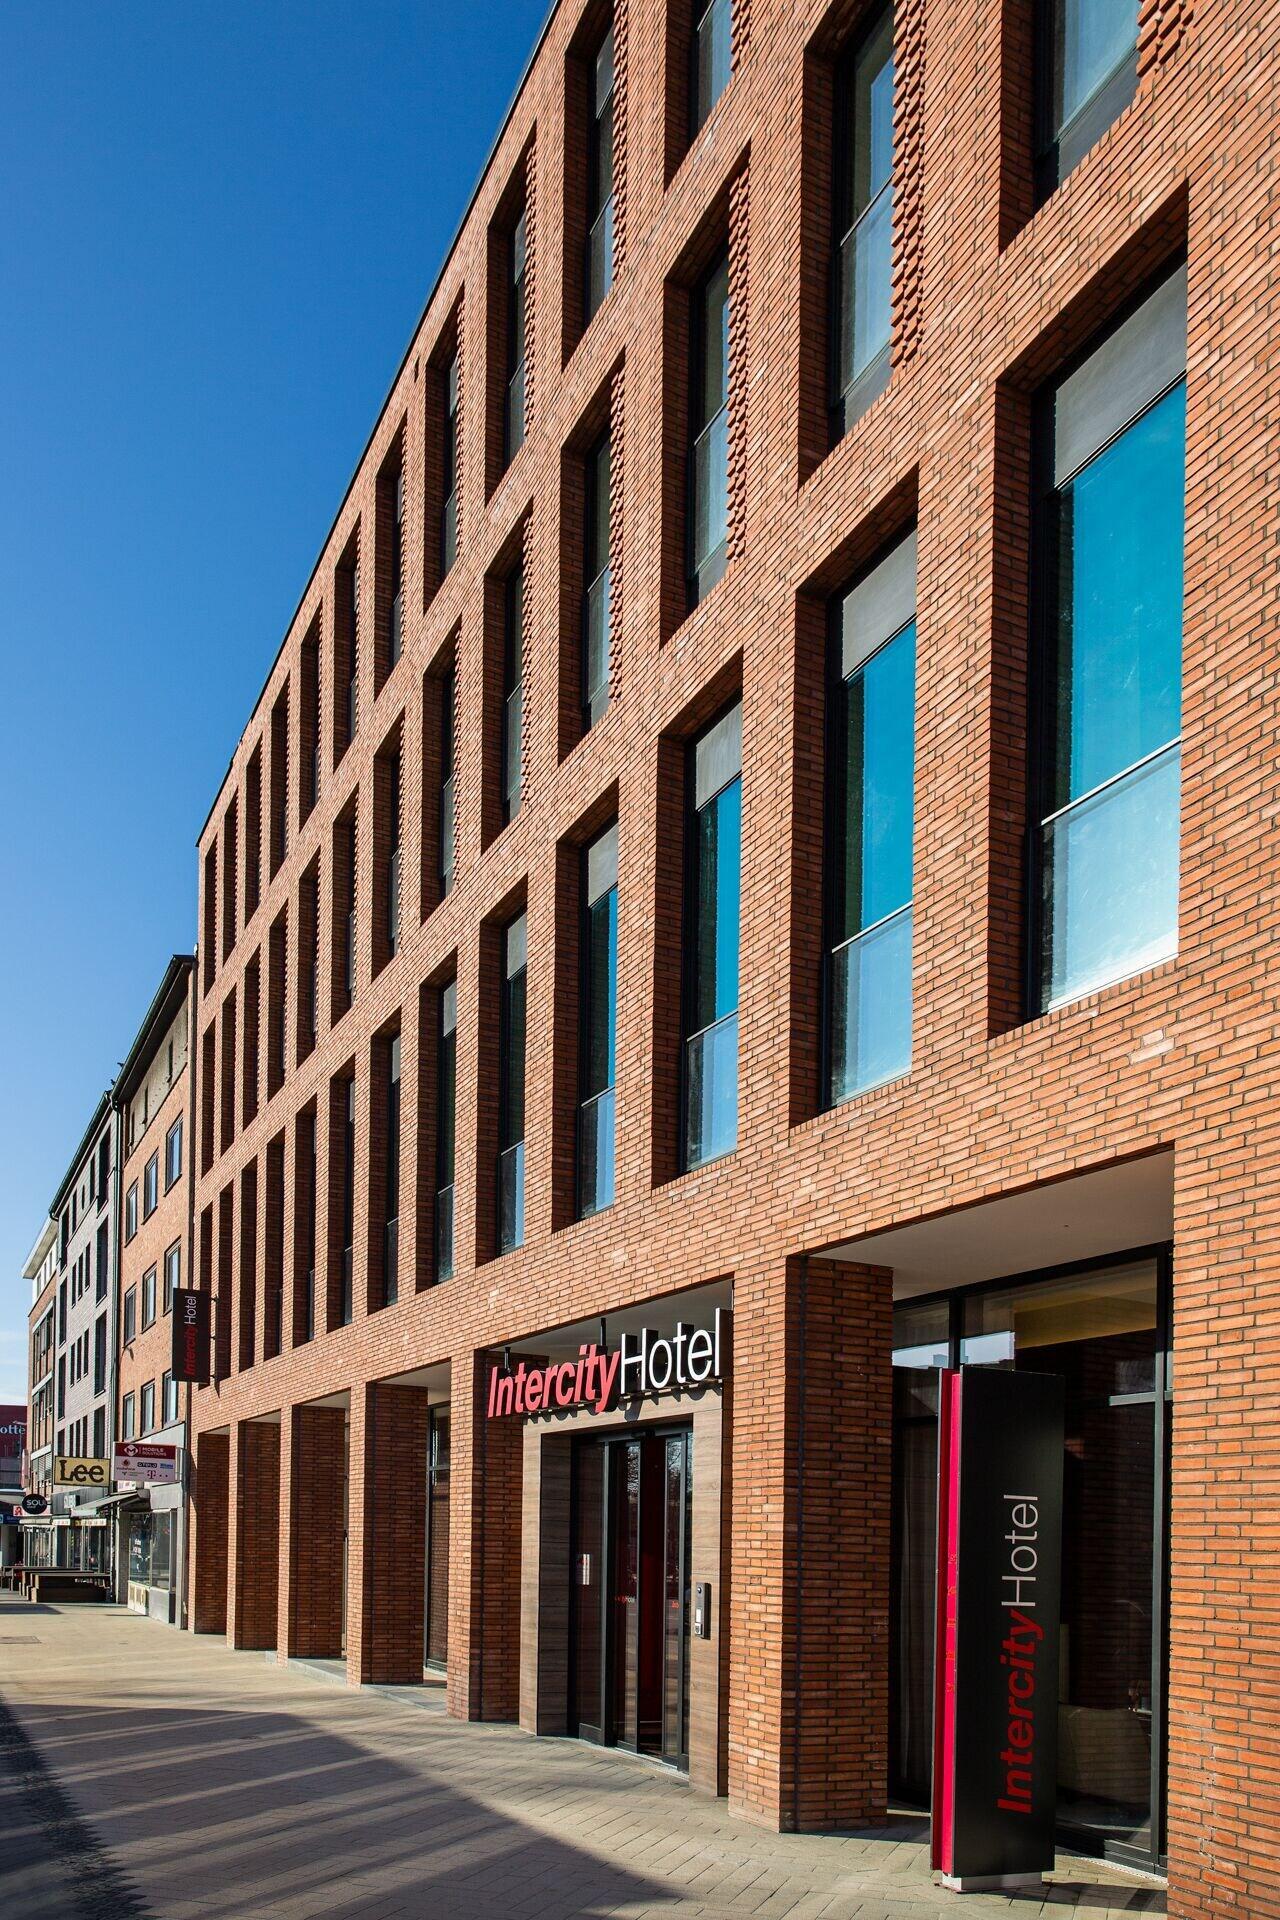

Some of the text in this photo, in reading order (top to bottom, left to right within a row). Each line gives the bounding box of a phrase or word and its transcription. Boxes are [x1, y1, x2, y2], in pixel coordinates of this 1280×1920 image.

[487, 1307, 721, 1419] IntercityHotel
[59, 1460, 104, 1483] Lee
[997, 1494, 1044, 1813] IntercityHotel
